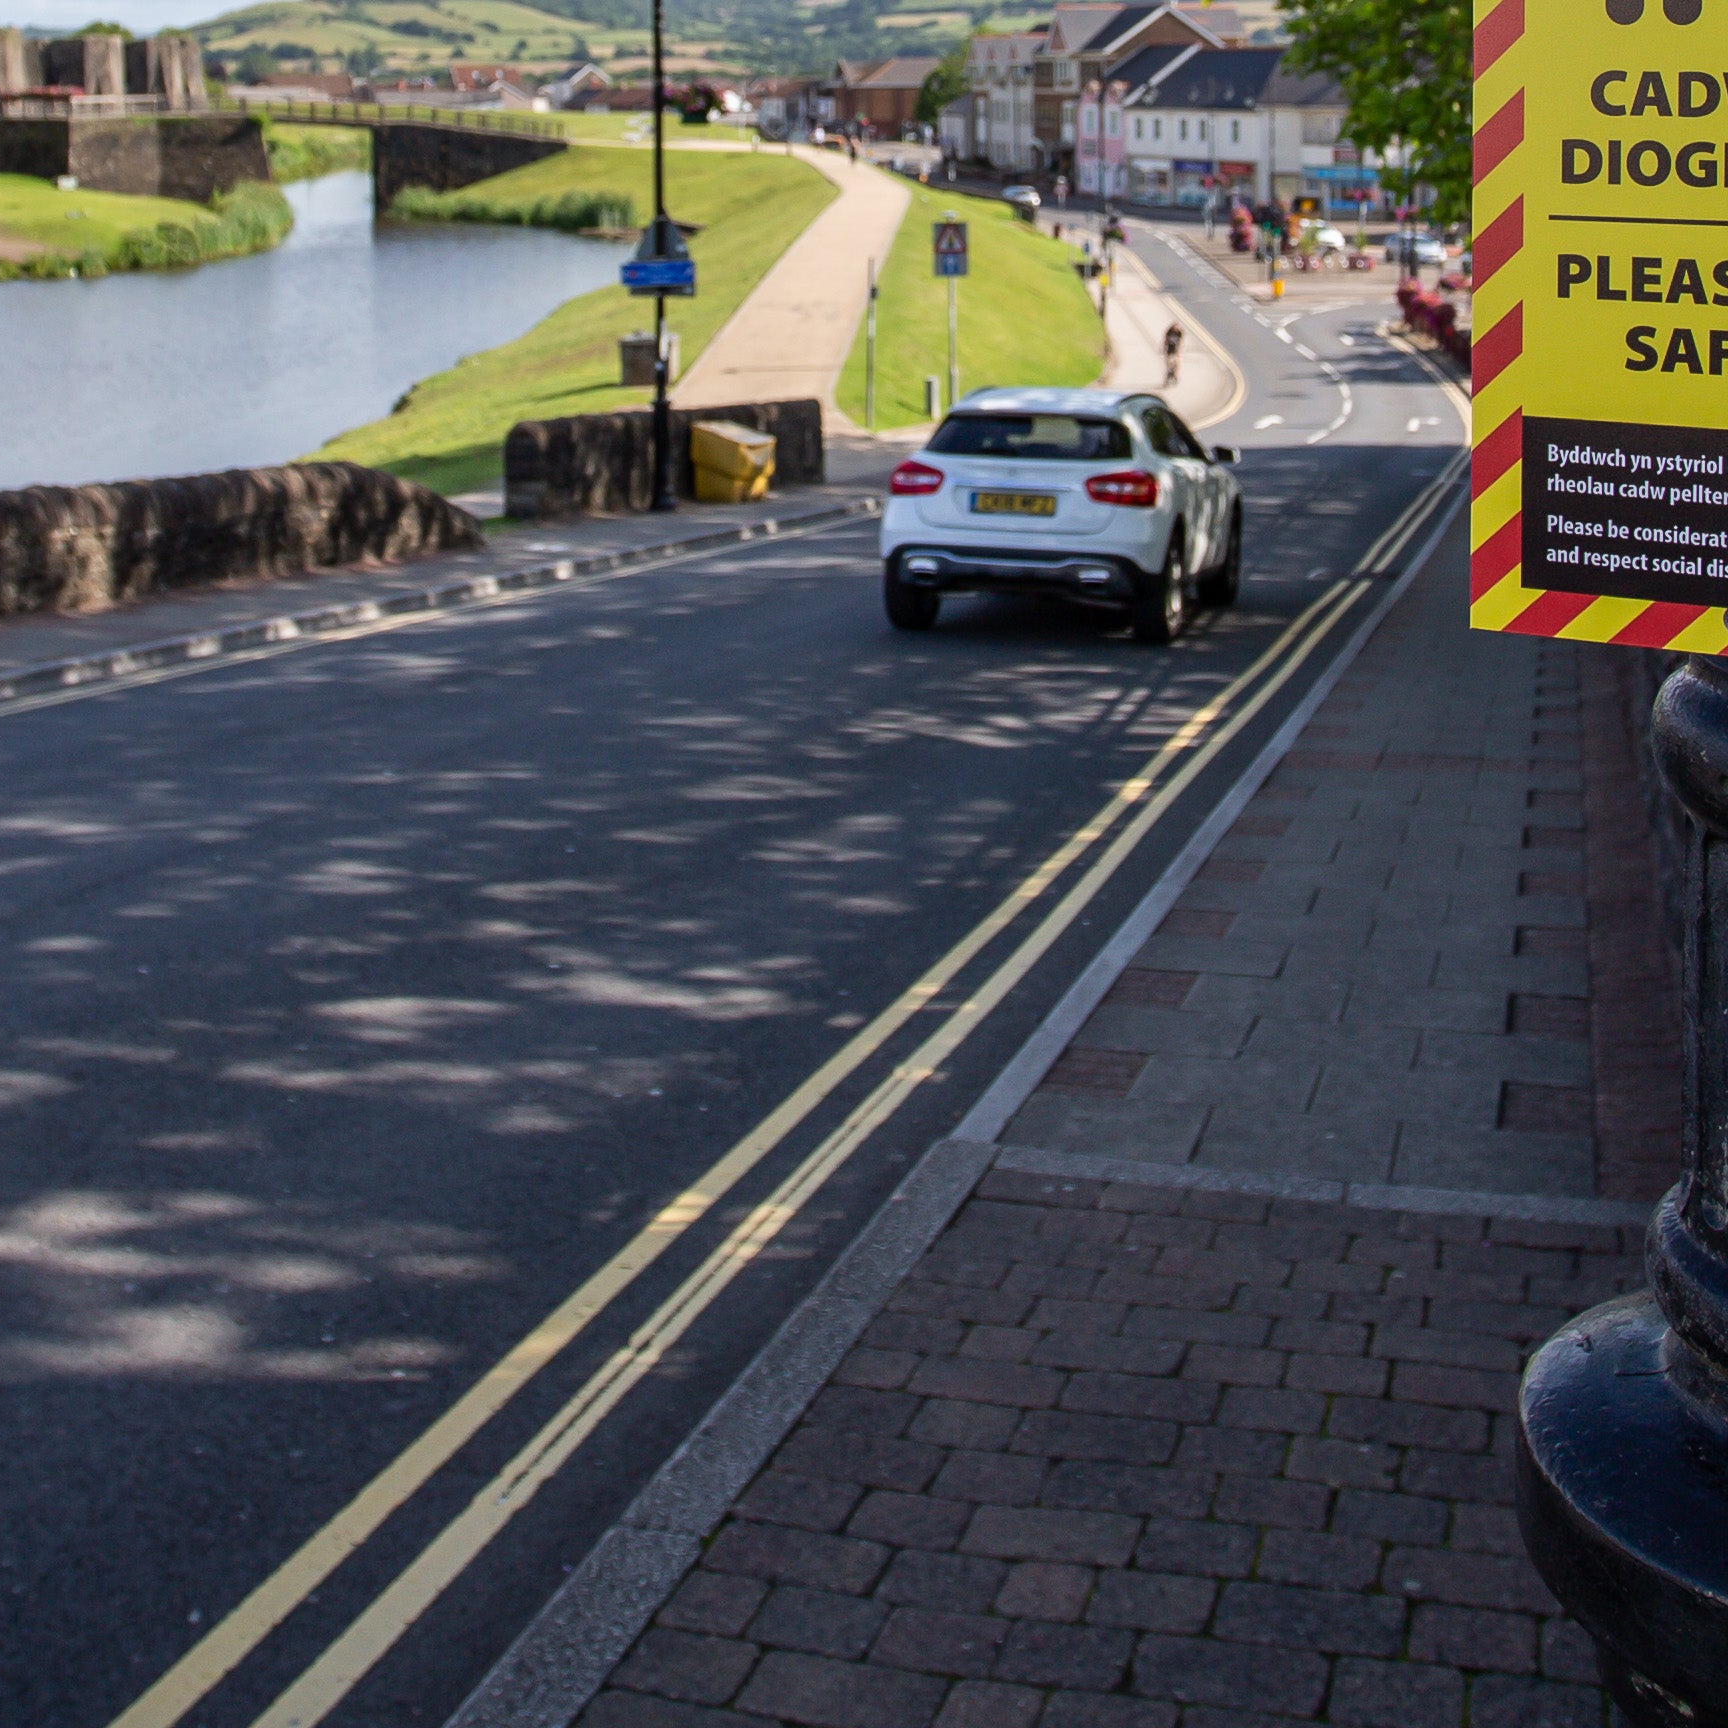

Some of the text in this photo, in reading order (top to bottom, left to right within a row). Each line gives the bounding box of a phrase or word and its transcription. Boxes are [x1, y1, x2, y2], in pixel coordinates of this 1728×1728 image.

[1547, 443, 1626, 468] Byddwch
[1630, 454, 1652, 474] yn
[1656, 454, 1724, 478] ystyriol
[1547, 473, 1615, 497] rheolau
[1618, 479, 1666, 501] cadw
[1547, 514, 1604, 537] Please
[1607, 519, 1630, 540] be
[1546, 545, 1580, 565] and
[1583, 551, 1649, 573] respect
[1651, 555, 1703, 576] social
